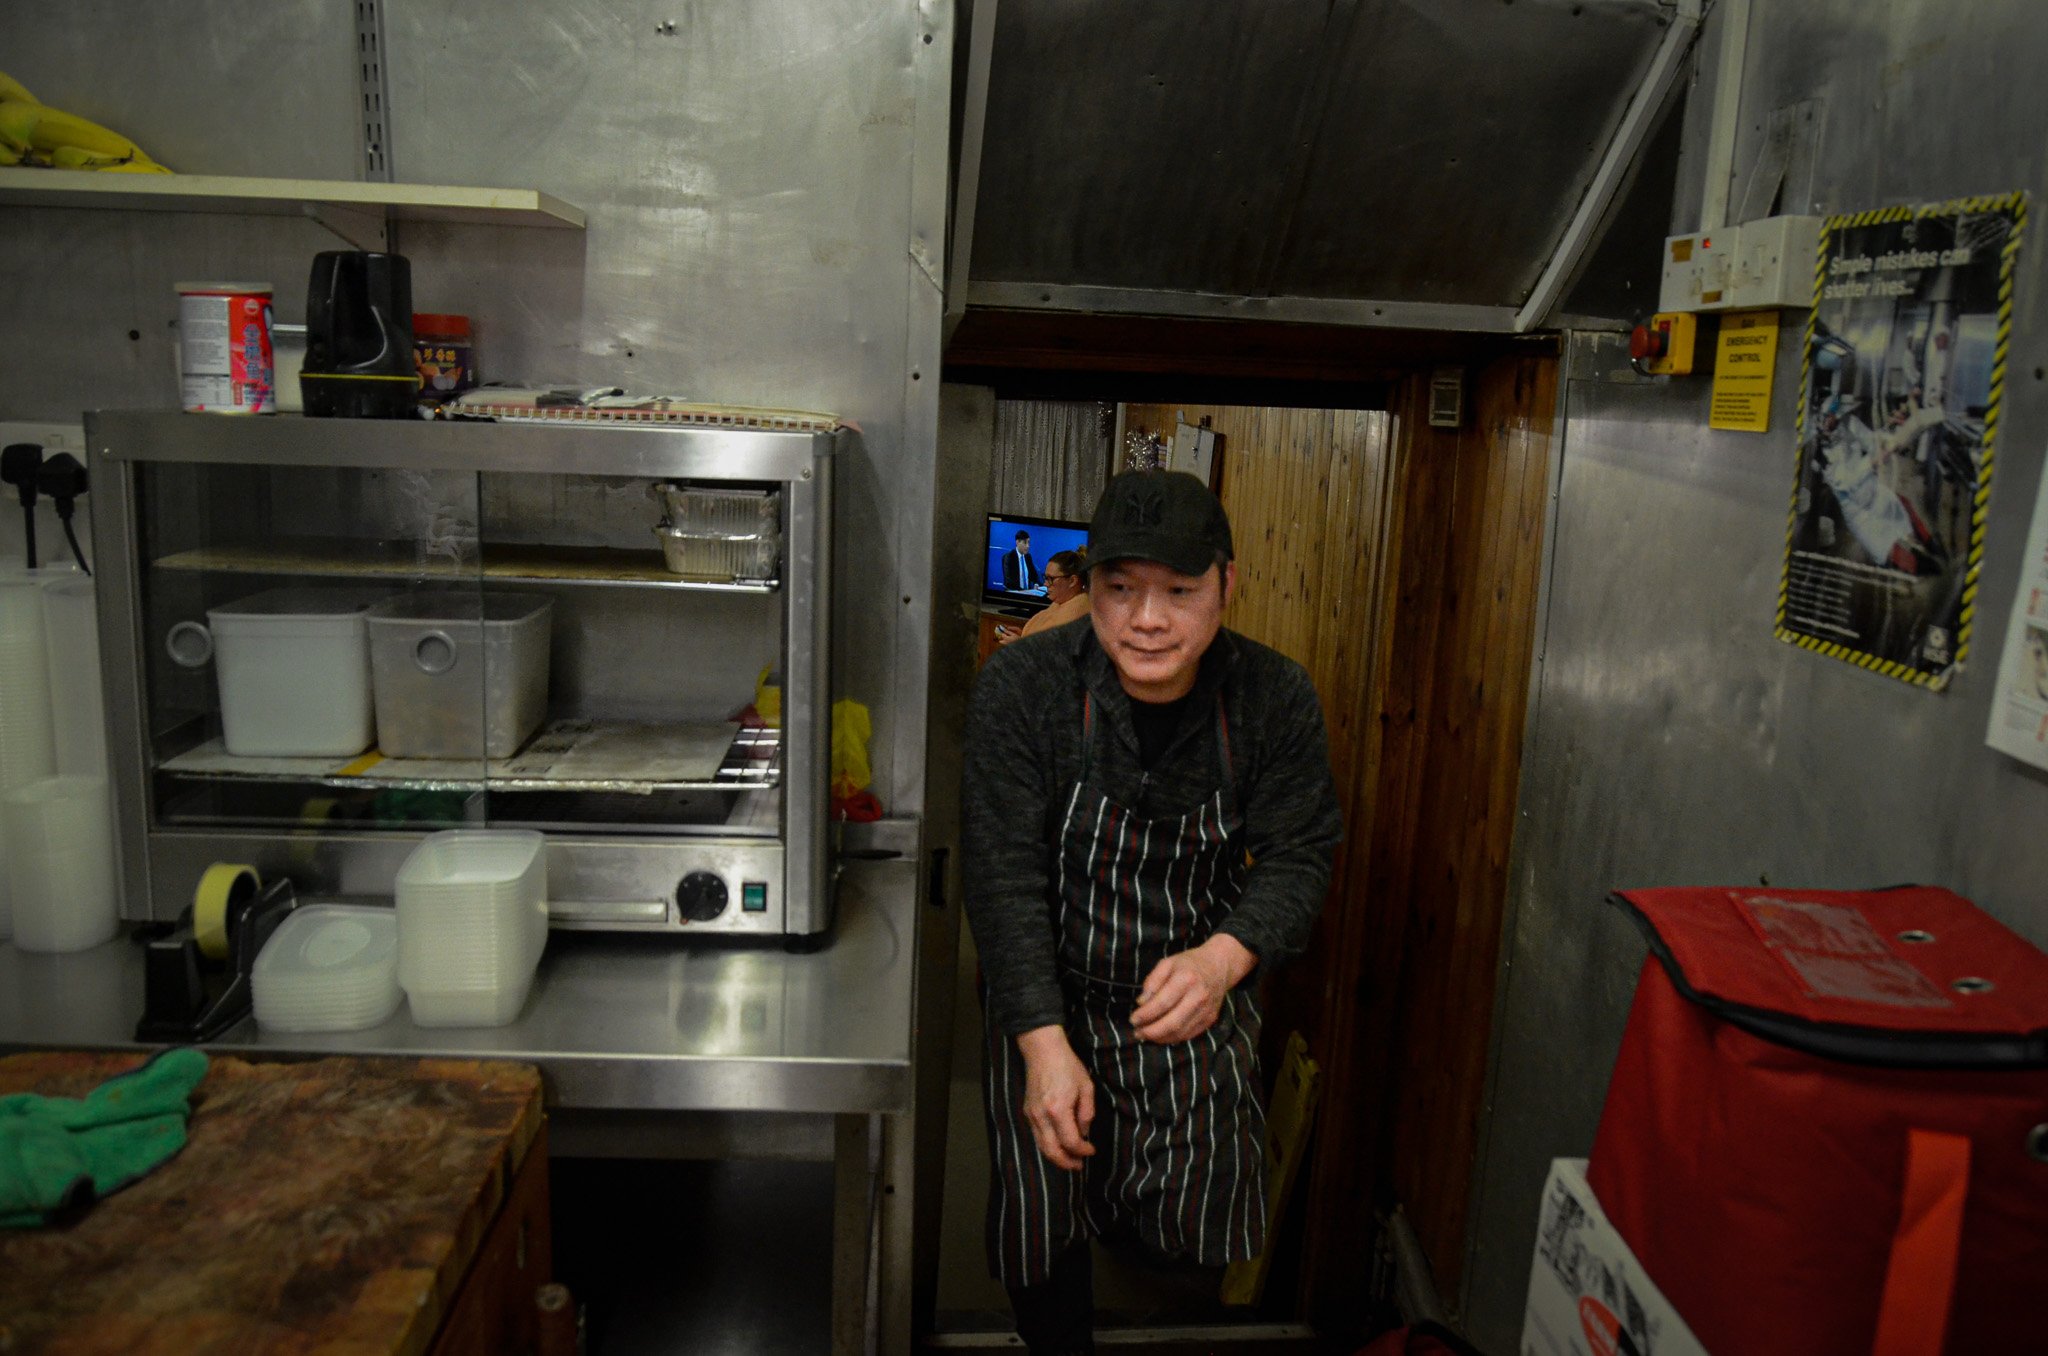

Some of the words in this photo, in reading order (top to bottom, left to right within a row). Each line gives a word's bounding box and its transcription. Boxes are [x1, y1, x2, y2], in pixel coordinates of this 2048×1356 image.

[1830, 253, 1873, 276] Simple
[1874, 247, 1939, 271] mistakes
[1940, 248, 1971, 267] can
[1823, 279, 1870, 299] shatter
[1726, 335, 1769, 347] EMERGENCY
[1728, 352, 1761, 363] CONTROL
